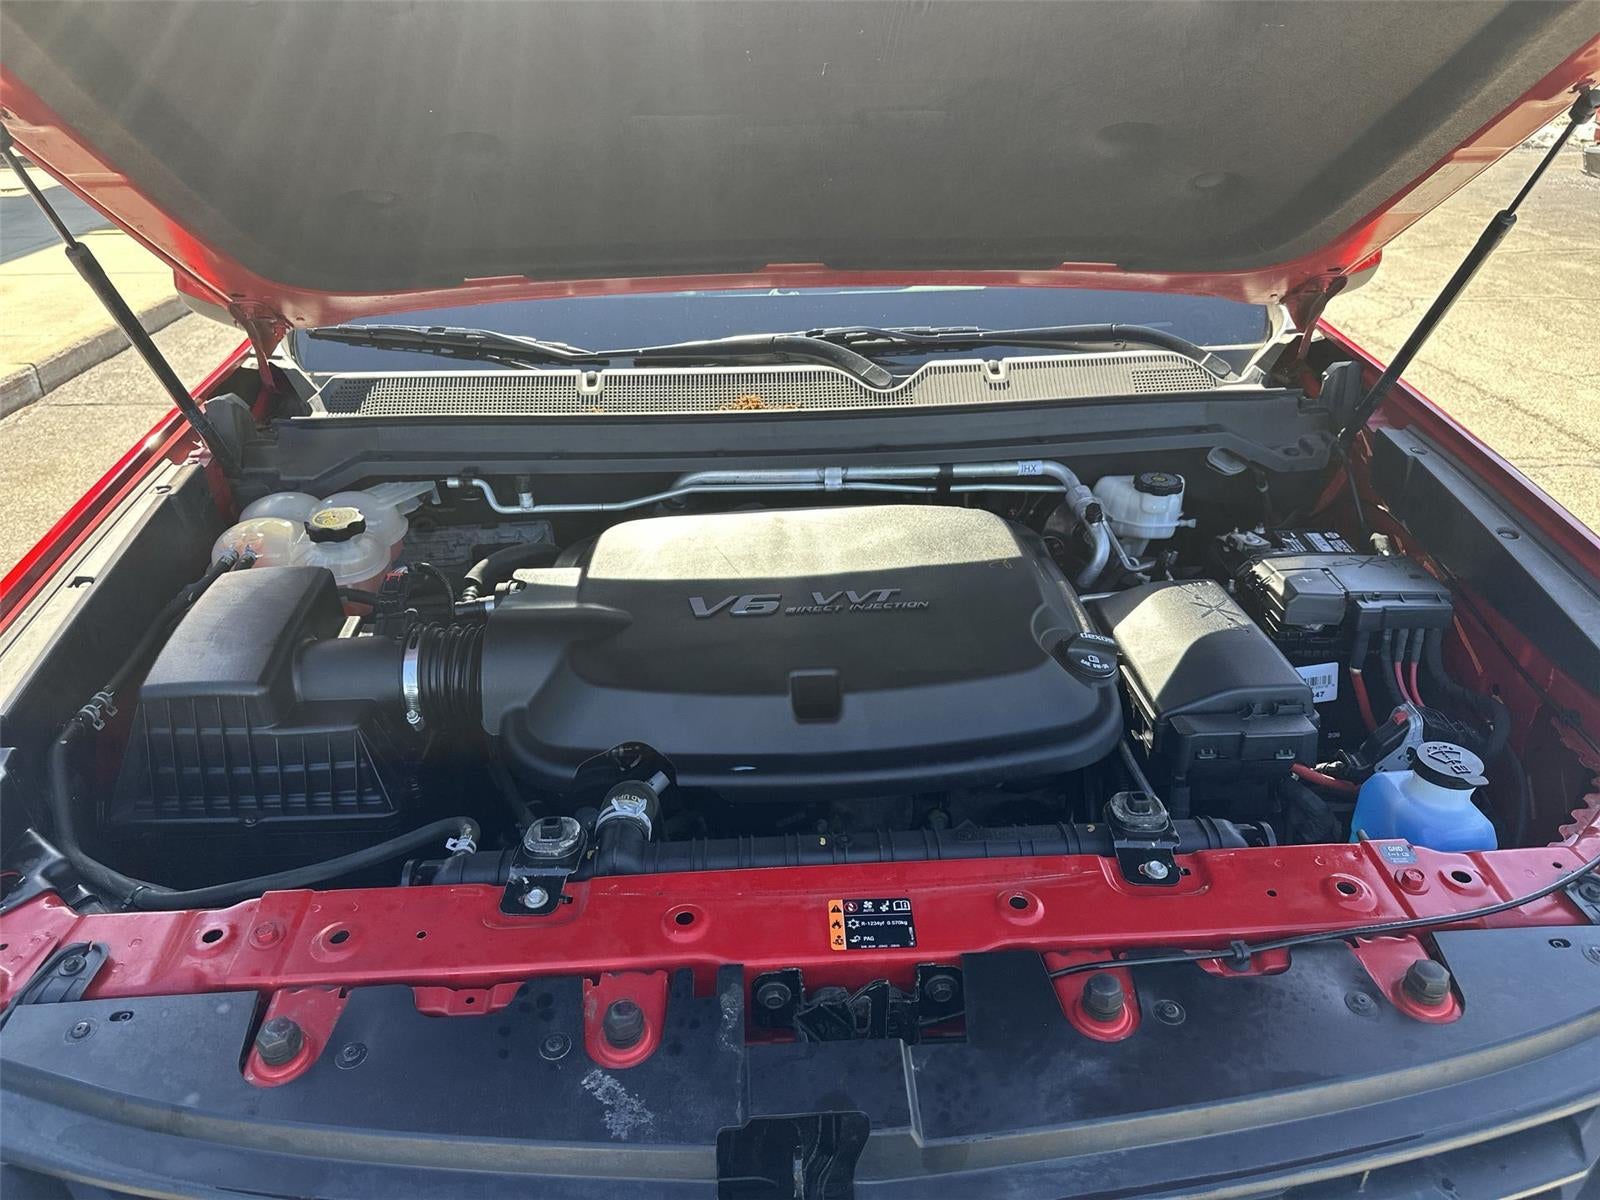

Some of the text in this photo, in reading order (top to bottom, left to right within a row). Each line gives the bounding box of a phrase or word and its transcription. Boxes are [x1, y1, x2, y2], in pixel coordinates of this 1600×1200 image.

[811, 588, 902, 605] VVT
[688, 593, 783, 618] V6
[784, 600, 930, 616] DIRECT INJECTION
